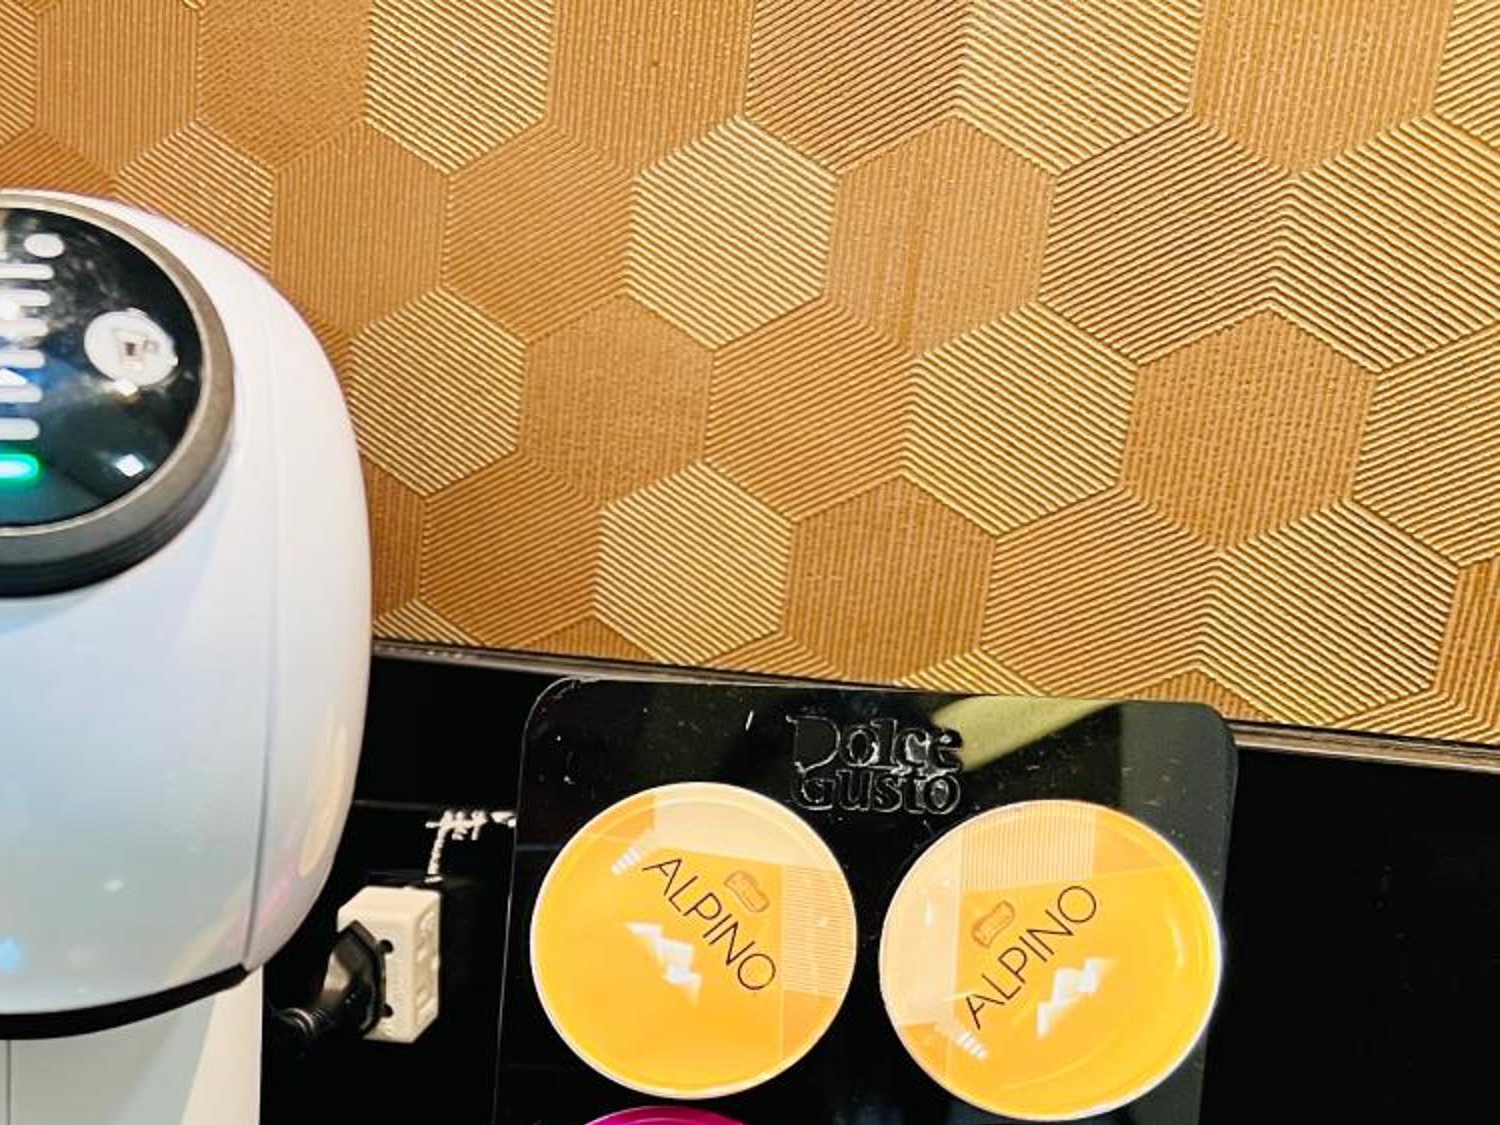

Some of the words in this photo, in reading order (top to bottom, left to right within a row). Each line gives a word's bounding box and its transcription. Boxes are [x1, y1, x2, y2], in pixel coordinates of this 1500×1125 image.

[785, 715, 963, 773] Dolce
[790, 768, 961, 815] Gusto
[642, 858, 776, 990] ALPINO
[966, 885, 1097, 1030] ALPINO
